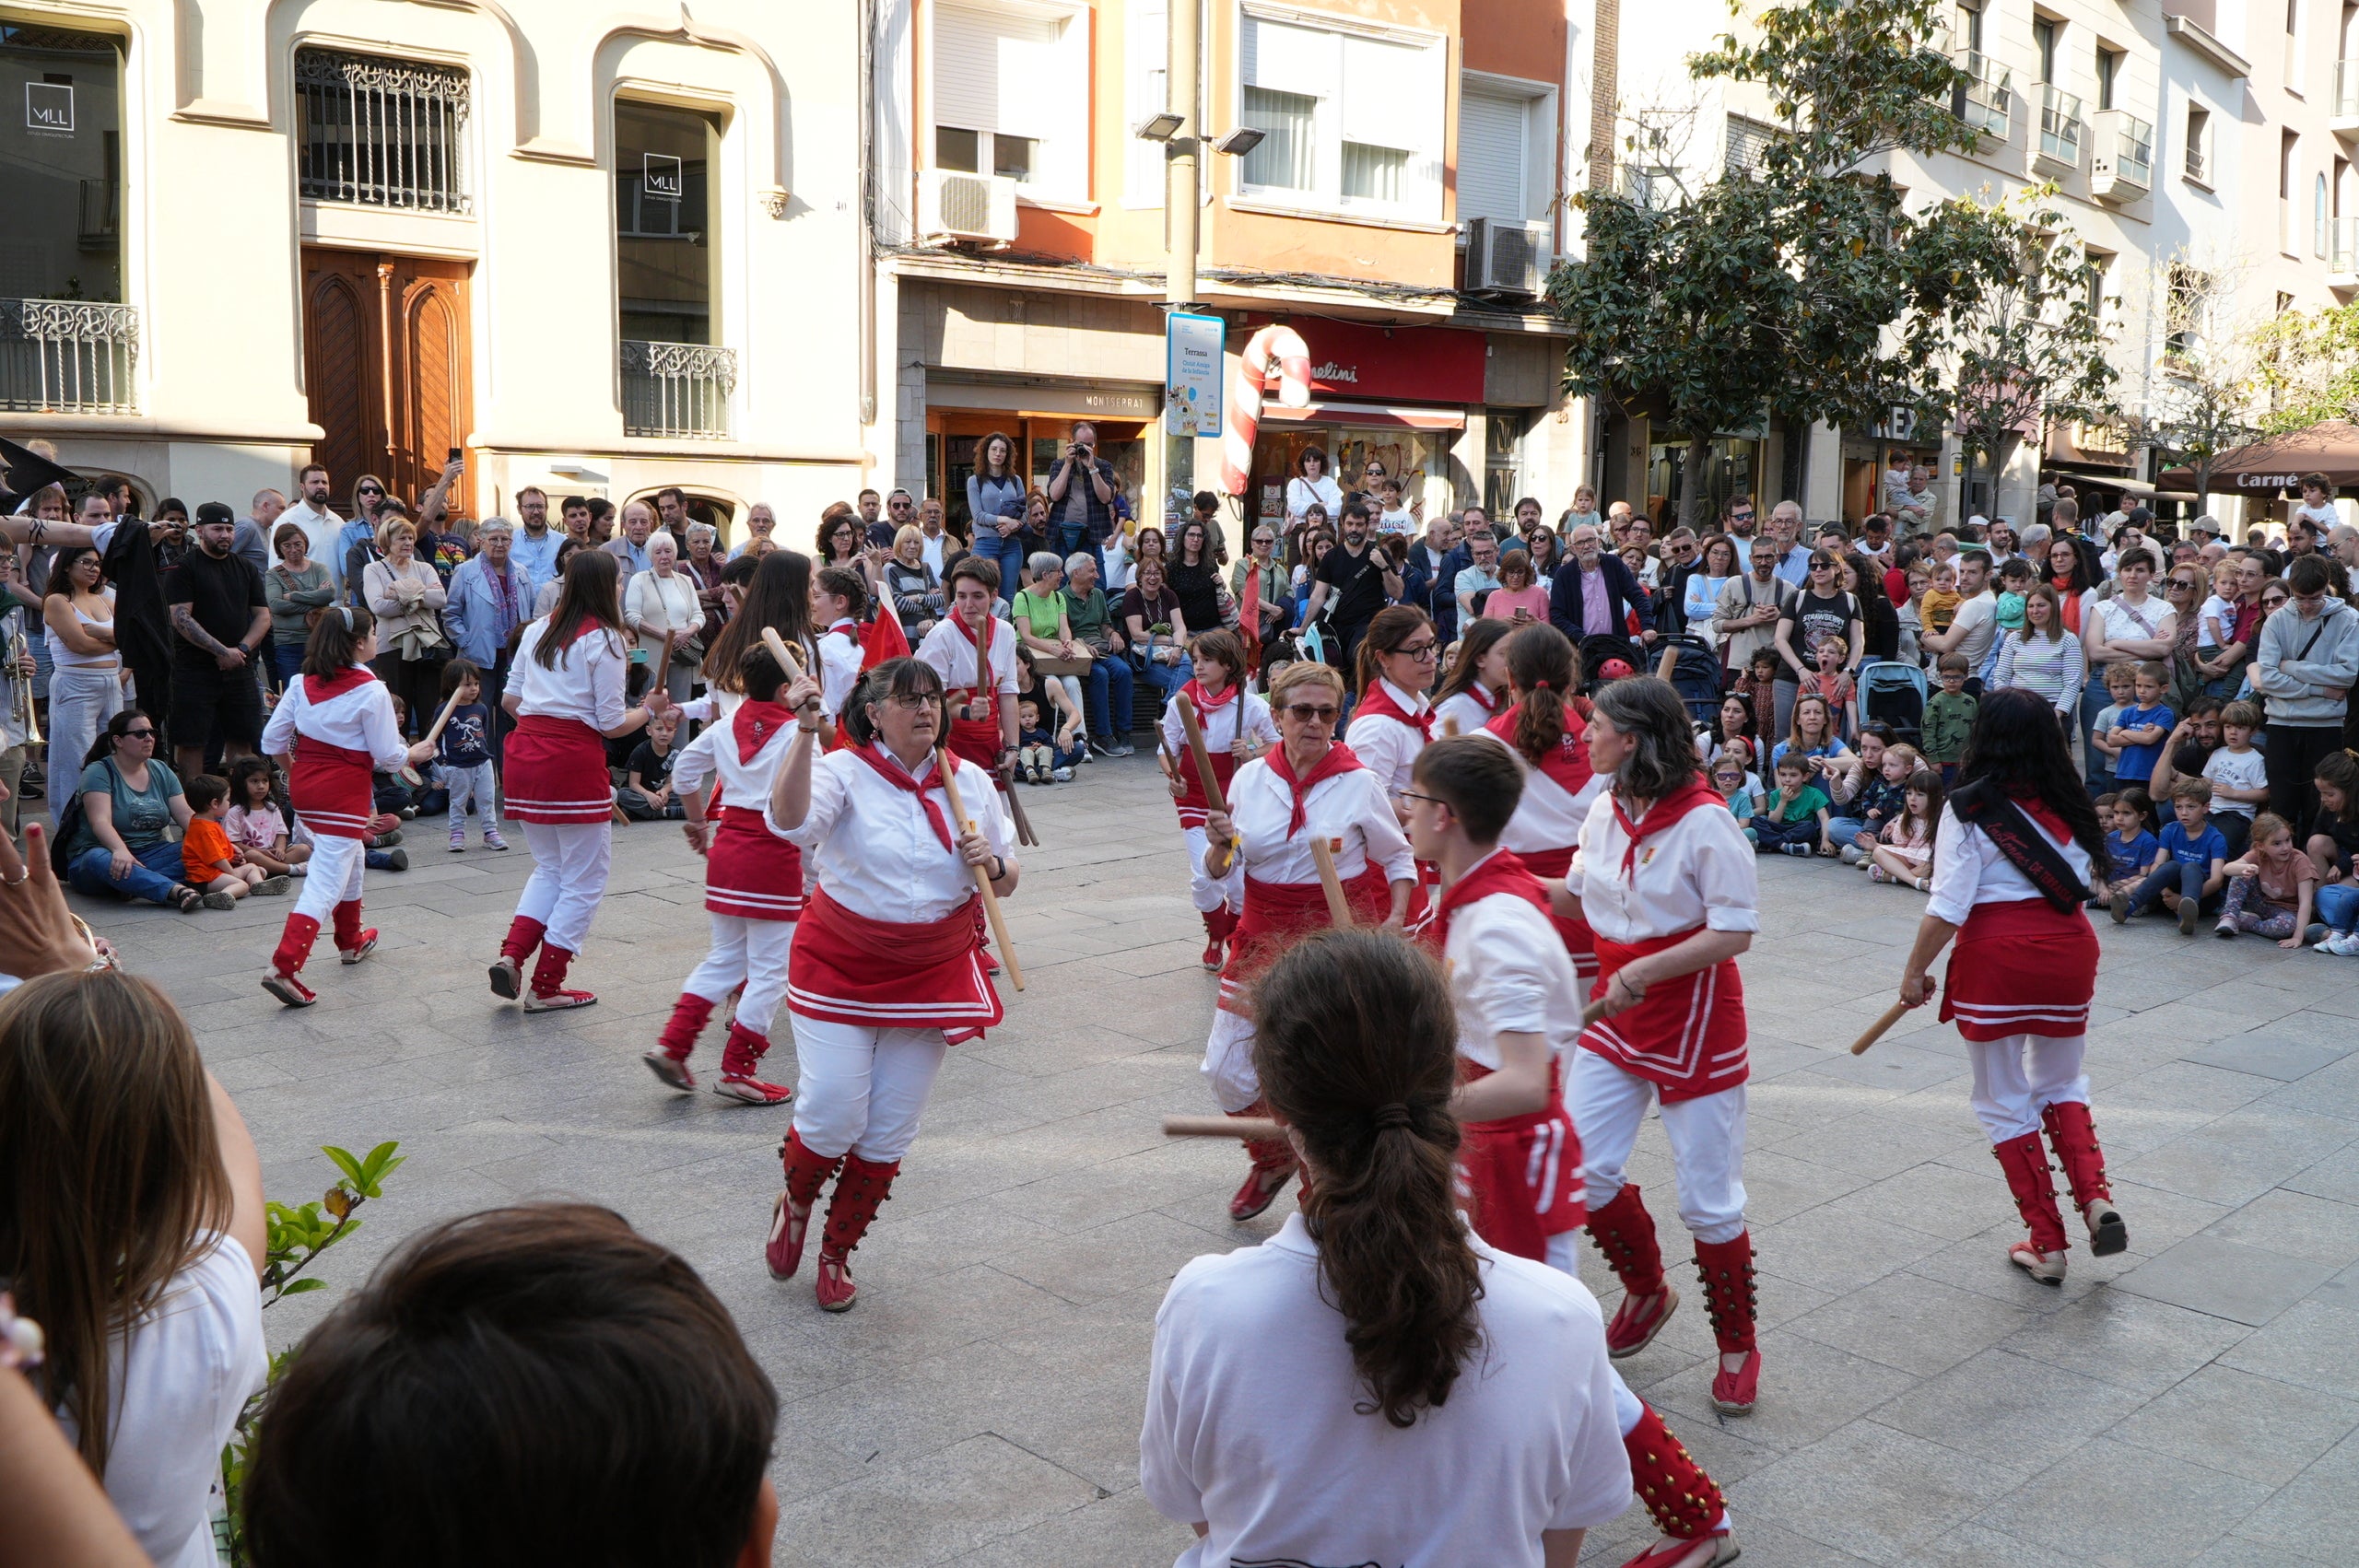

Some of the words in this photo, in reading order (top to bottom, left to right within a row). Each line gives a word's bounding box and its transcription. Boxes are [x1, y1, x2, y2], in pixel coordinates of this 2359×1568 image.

[33, 107, 68, 125] MLL
[649, 175, 677, 191] MLL
[1184, 347, 1208, 357] Terrassa
[2236, 472, 2298, 487] Carné
[1802, 613, 1845, 626] STRAWBERRY
